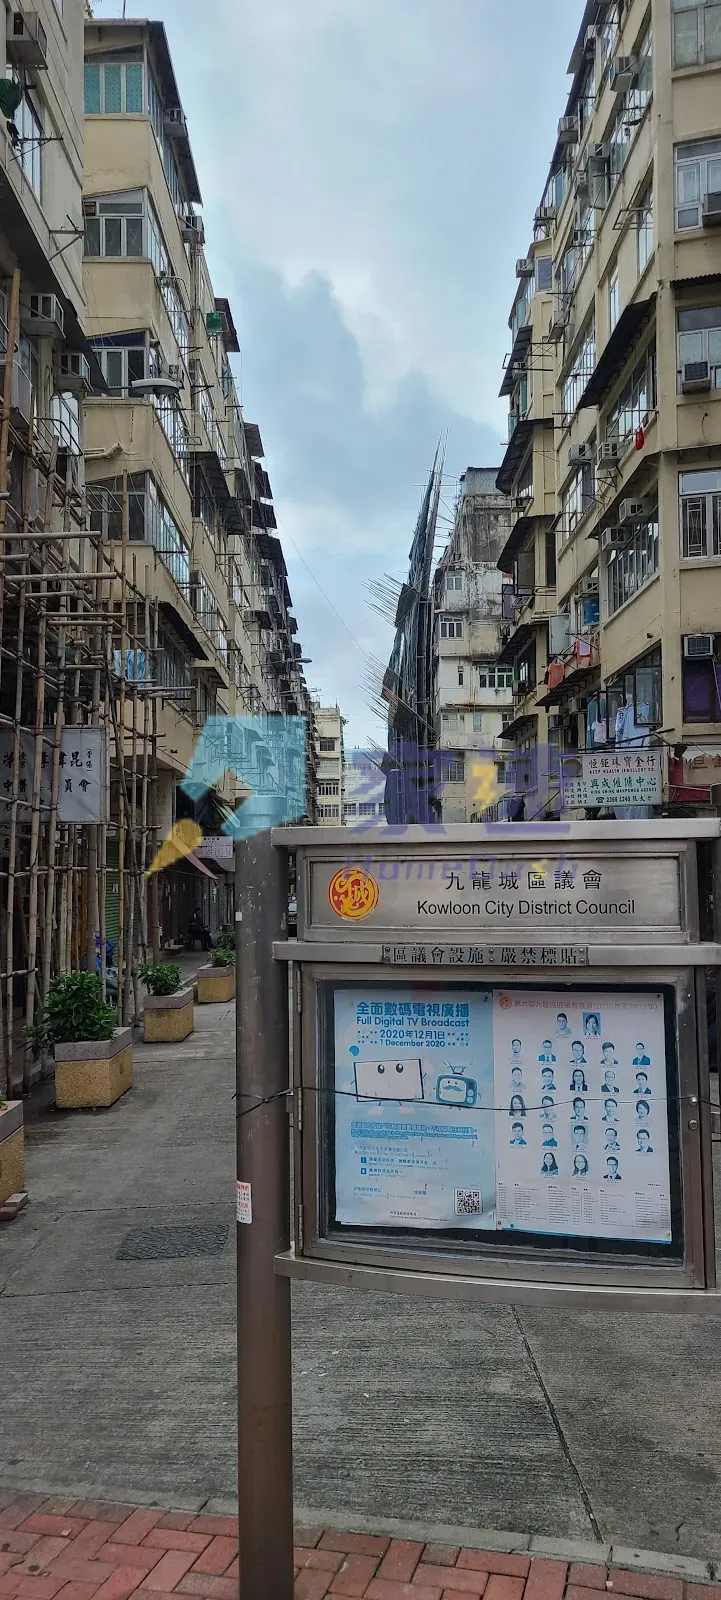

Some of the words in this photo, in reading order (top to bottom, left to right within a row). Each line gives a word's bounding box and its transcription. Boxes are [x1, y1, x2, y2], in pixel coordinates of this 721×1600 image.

[445, 869, 603, 891] 九龍城區議會
[417, 901, 481, 915] Kowloon
[484, 900, 515, 918] City
[518, 900, 572, 915] District
[575, 899, 636, 914] Council
[393, 947, 484, 964] 區議會設施
[500, 947, 578, 964] 嚴禁標貼
[356, 1001, 470, 1018] 全面數碼電視廣播
[356, 1016, 372, 1025] Full
[374, 1017, 405, 1028] Digital
[407, 1017, 419, 1027] TV
[421, 1017, 470, 1028] Broadcast
[380, 1029, 445, 1040] 2020年12月1日
[385, 1039, 424, 1048] December
[425, 1040, 446, 1048] 2020
